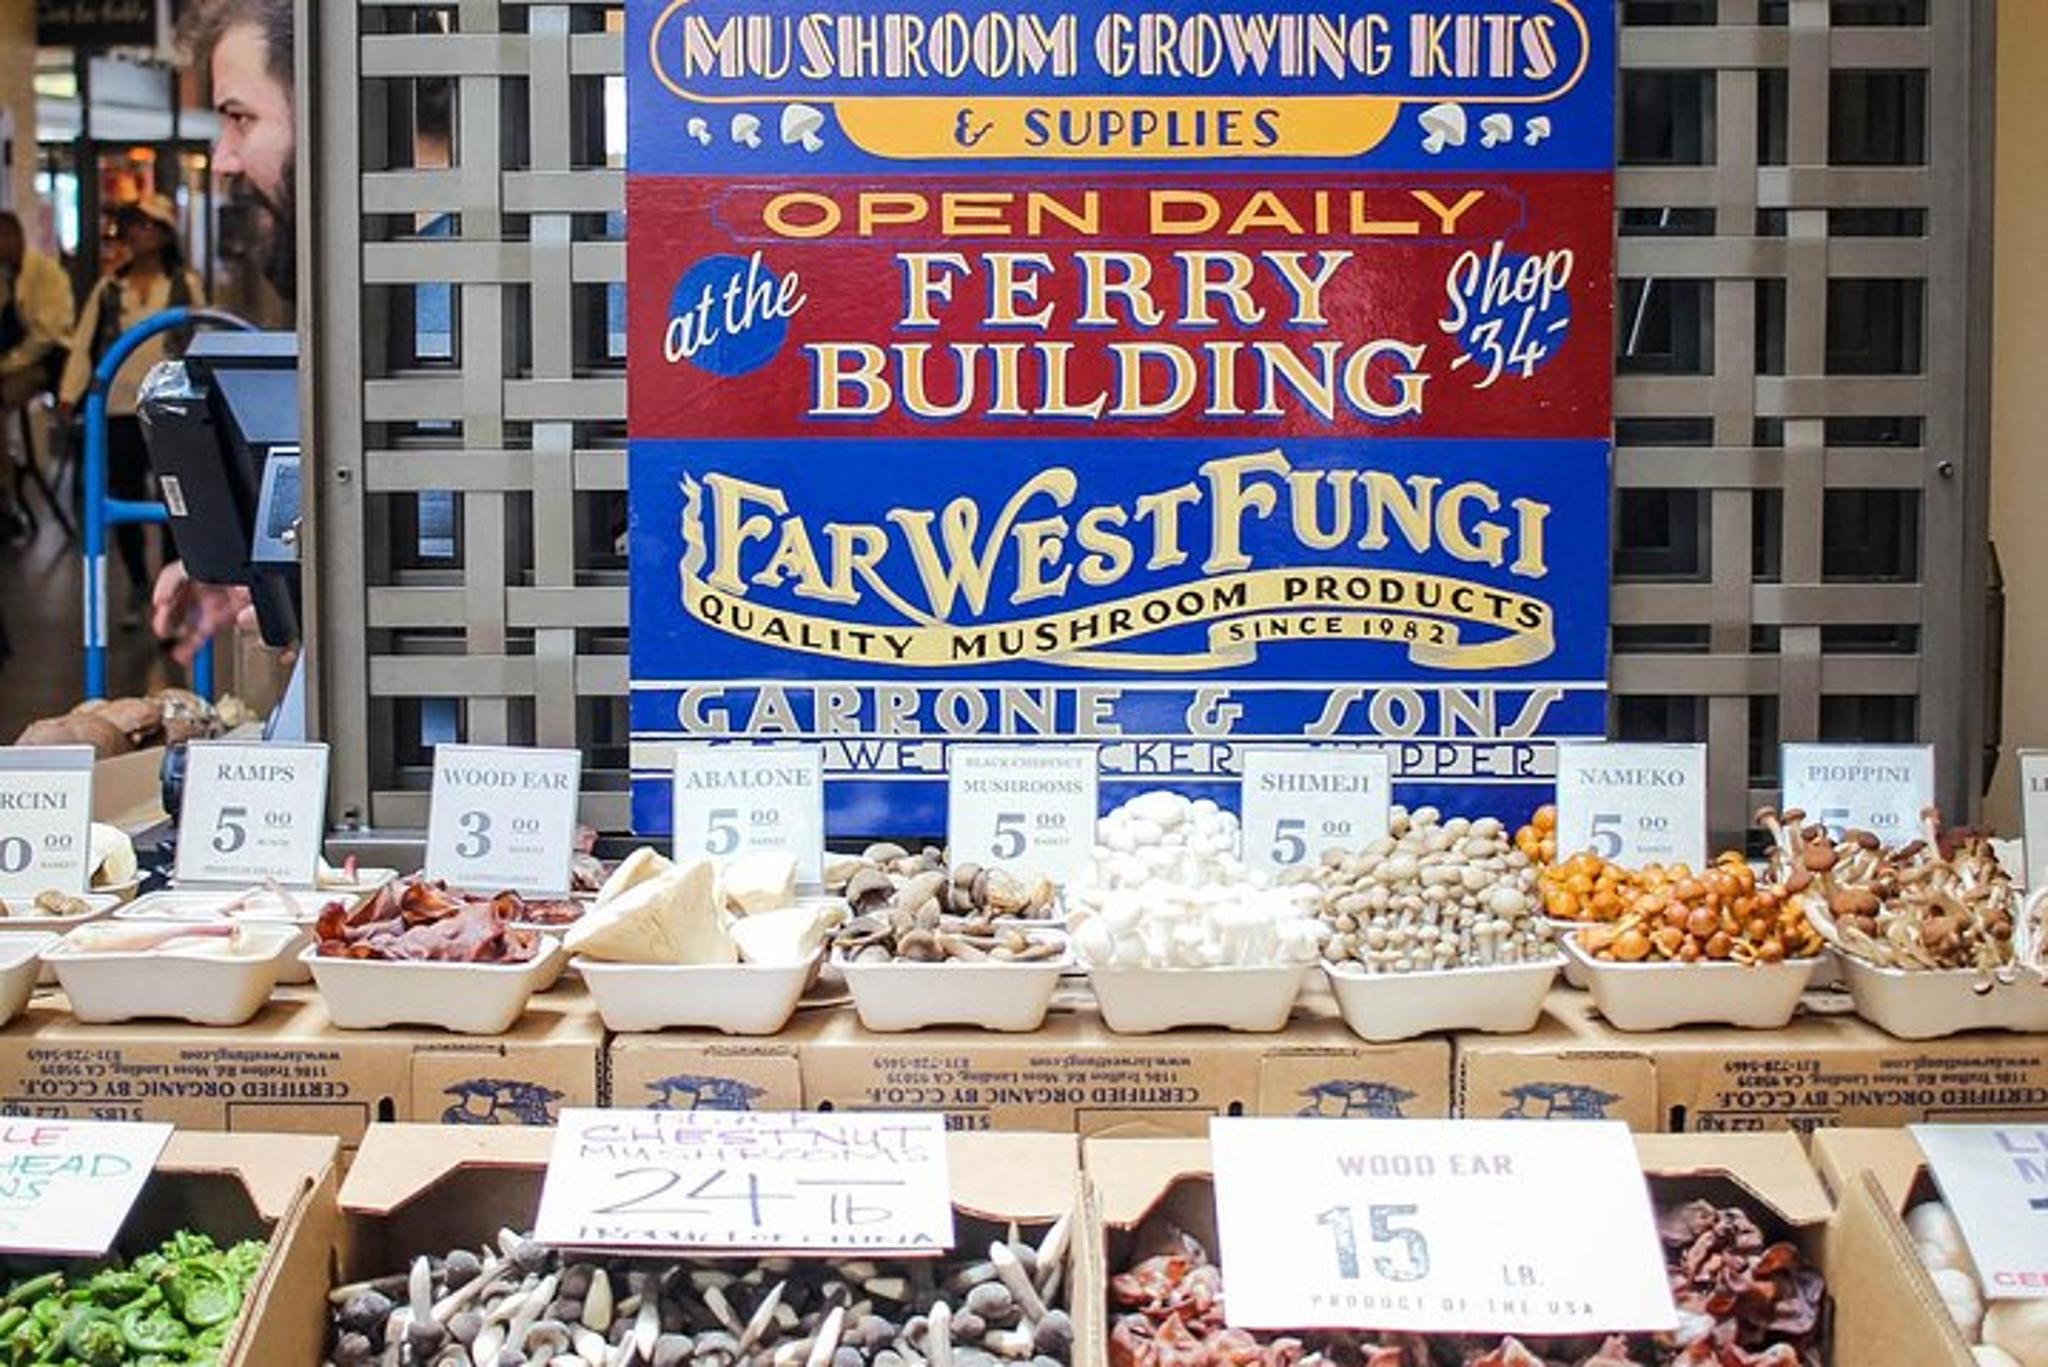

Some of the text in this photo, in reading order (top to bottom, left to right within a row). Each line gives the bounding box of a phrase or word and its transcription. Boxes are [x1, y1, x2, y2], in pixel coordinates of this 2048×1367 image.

[683, 12, 1558, 80] MUSHROOM GROWING KITS
[953, 107, 1281, 147] & SUPPLIES
[762, 190, 1486, 238] OPEN DAILY
[893, 249, 1355, 330] FERRY
[1438, 240, 1575, 333] Shop
[663, 249, 808, 364] at the
[800, 338, 1431, 424] BUILDING
[699, 574, 1544, 660] QUALITY MUSHROOM PRODUCTS
[1228, 616, 1446, 645] SINCE 1982
[678, 685, 1564, 738] GARRONE & SONS
[217, 763, 295, 782] RAMPS
[443, 767, 568, 790] WOOD EAR
[685, 768, 812, 789] ABALONE
[1260, 773, 1369, 794] SHIMEJI
[1577, 767, 1686, 787] NAMEKO
[1807, 765, 1911, 781] PIOPPINI
[963, 779, 1084, 794] MUSHROOMS
[211, 807, 293, 853] 5 00
[455, 811, 540, 858] 3 00
[704, 808, 779, 856] 5 00
[991, 812, 1067, 860] 5 00
[1272, 819, 1352, 865] 5 00
[1588, 813, 1668, 859] 5 00
[86, 1065, 107, 1075] CA
[934, 1072, 954, 1083] CA
[1785, 1075, 1804, 1087] CA
[105, 1081, 130, 1095] BY
[138, 1081, 236, 1097] ORGANIC
[239, 1081, 349, 1097] CERTIFIED
[953, 1089, 978, 1103] BY
[986, 1089, 1085, 1103] ORGANIC
[1091, 1088, 1199, 1103] CERTIFIED
[1804, 1090, 1828, 1107] BY
[1837, 1090, 1935, 1106] ORGANIC
[1942, 1089, 2047, 1105] CERTIFIED
[581, 1124, 932, 1149] CHESTNUT
[1336, 1153, 1514, 1177] WOOD EAR
[592, 1167, 796, 1227] 24
[1316, 1203, 1431, 1283] 15
